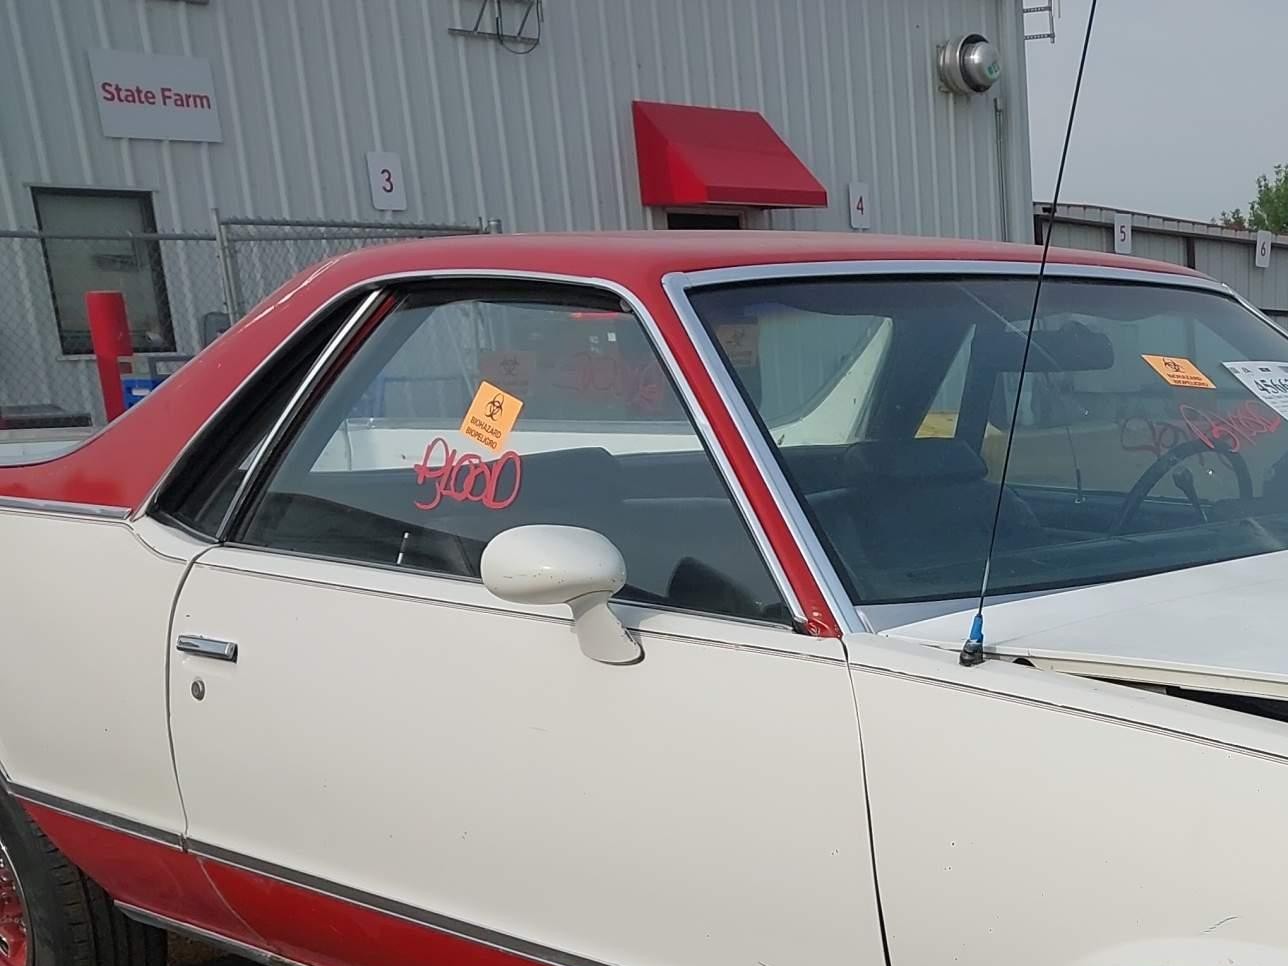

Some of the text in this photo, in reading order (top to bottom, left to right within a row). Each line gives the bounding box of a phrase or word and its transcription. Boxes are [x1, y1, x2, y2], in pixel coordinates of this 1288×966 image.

[101, 82, 212, 110] State Farm
[380, 168, 394, 193] 3
[856, 194, 865, 216] 4
[1119, 224, 1127, 242] 5
[1260, 240, 1267, 257] 6
[465, 426, 498, 449] BIOPELIGRO
[470, 416, 502, 438] BIOHAZARD
